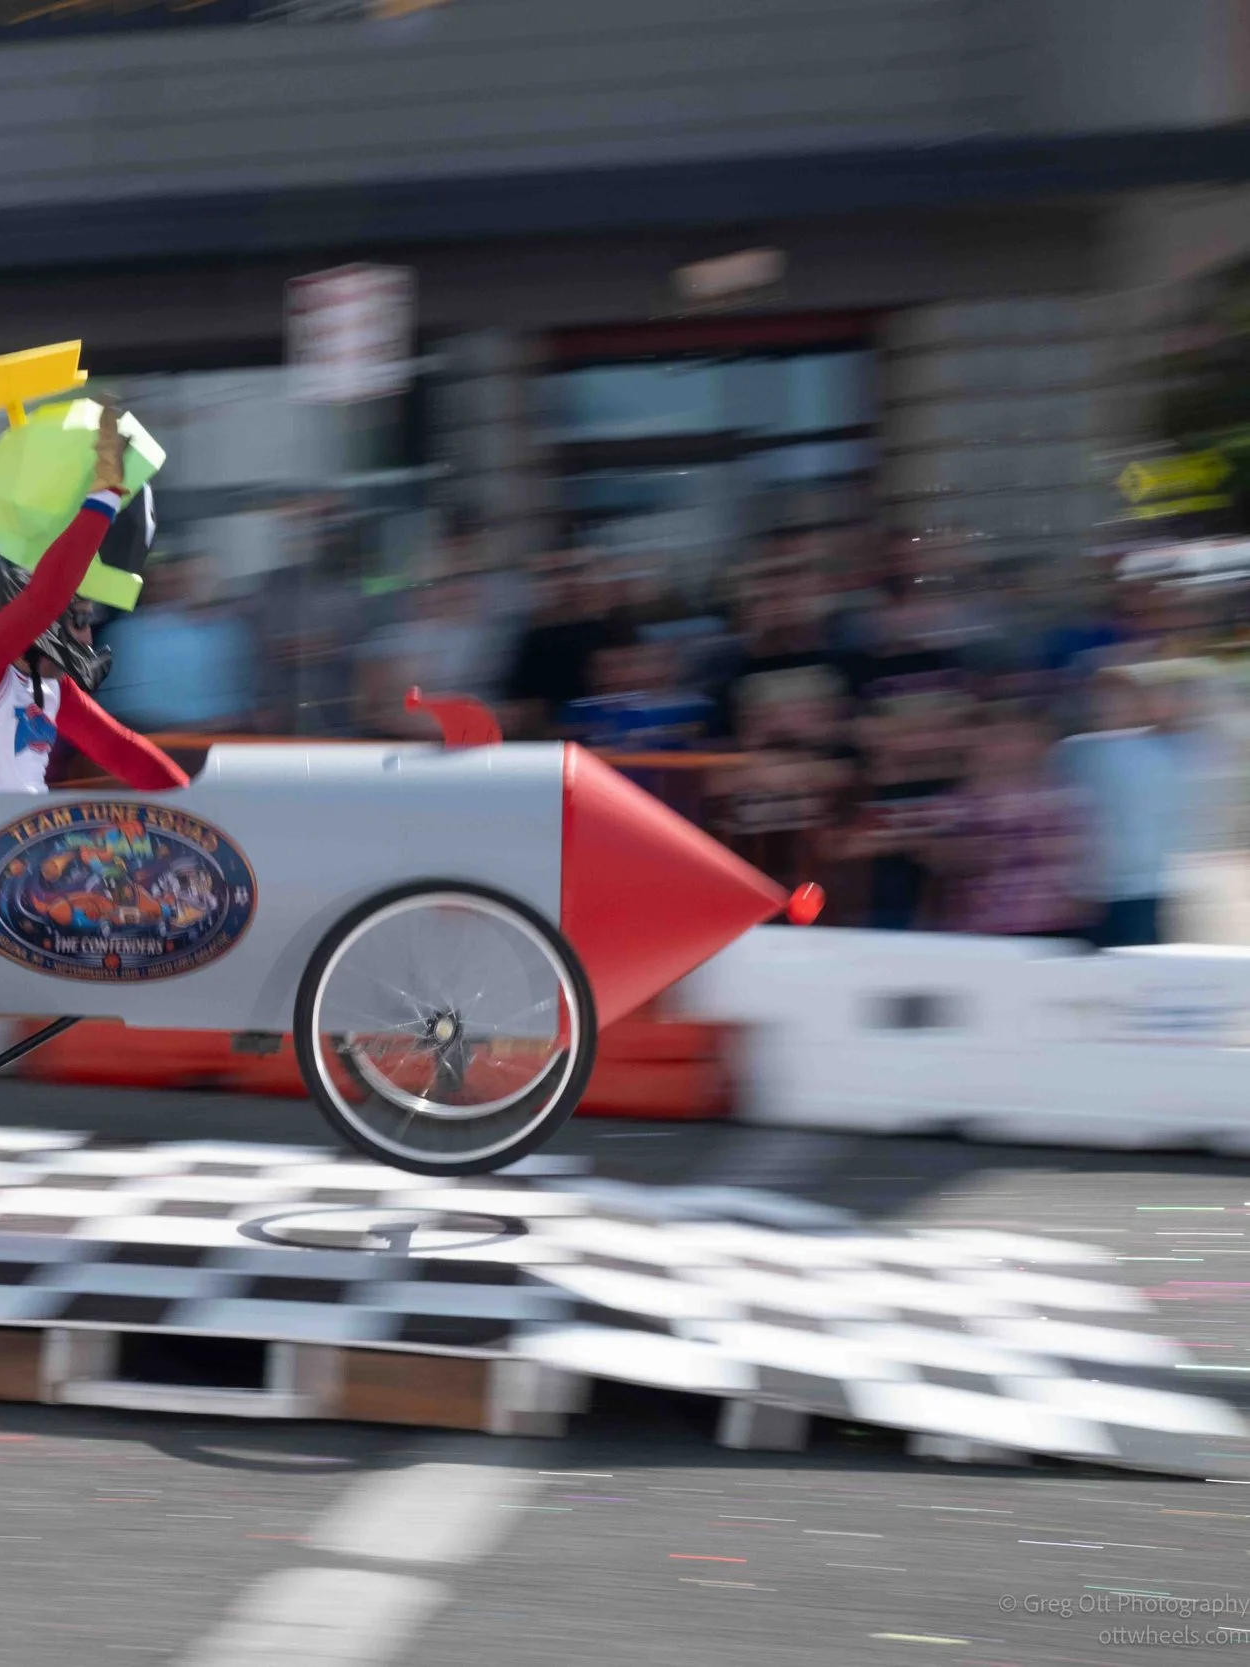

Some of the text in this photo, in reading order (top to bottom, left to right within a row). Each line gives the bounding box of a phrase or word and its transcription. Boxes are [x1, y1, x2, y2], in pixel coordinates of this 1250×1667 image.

[9, 803, 218, 852] TEAM TUNE SQUAD
[55, 933, 80, 954] THE
[81, 935, 163, 956] CONTENDERS
